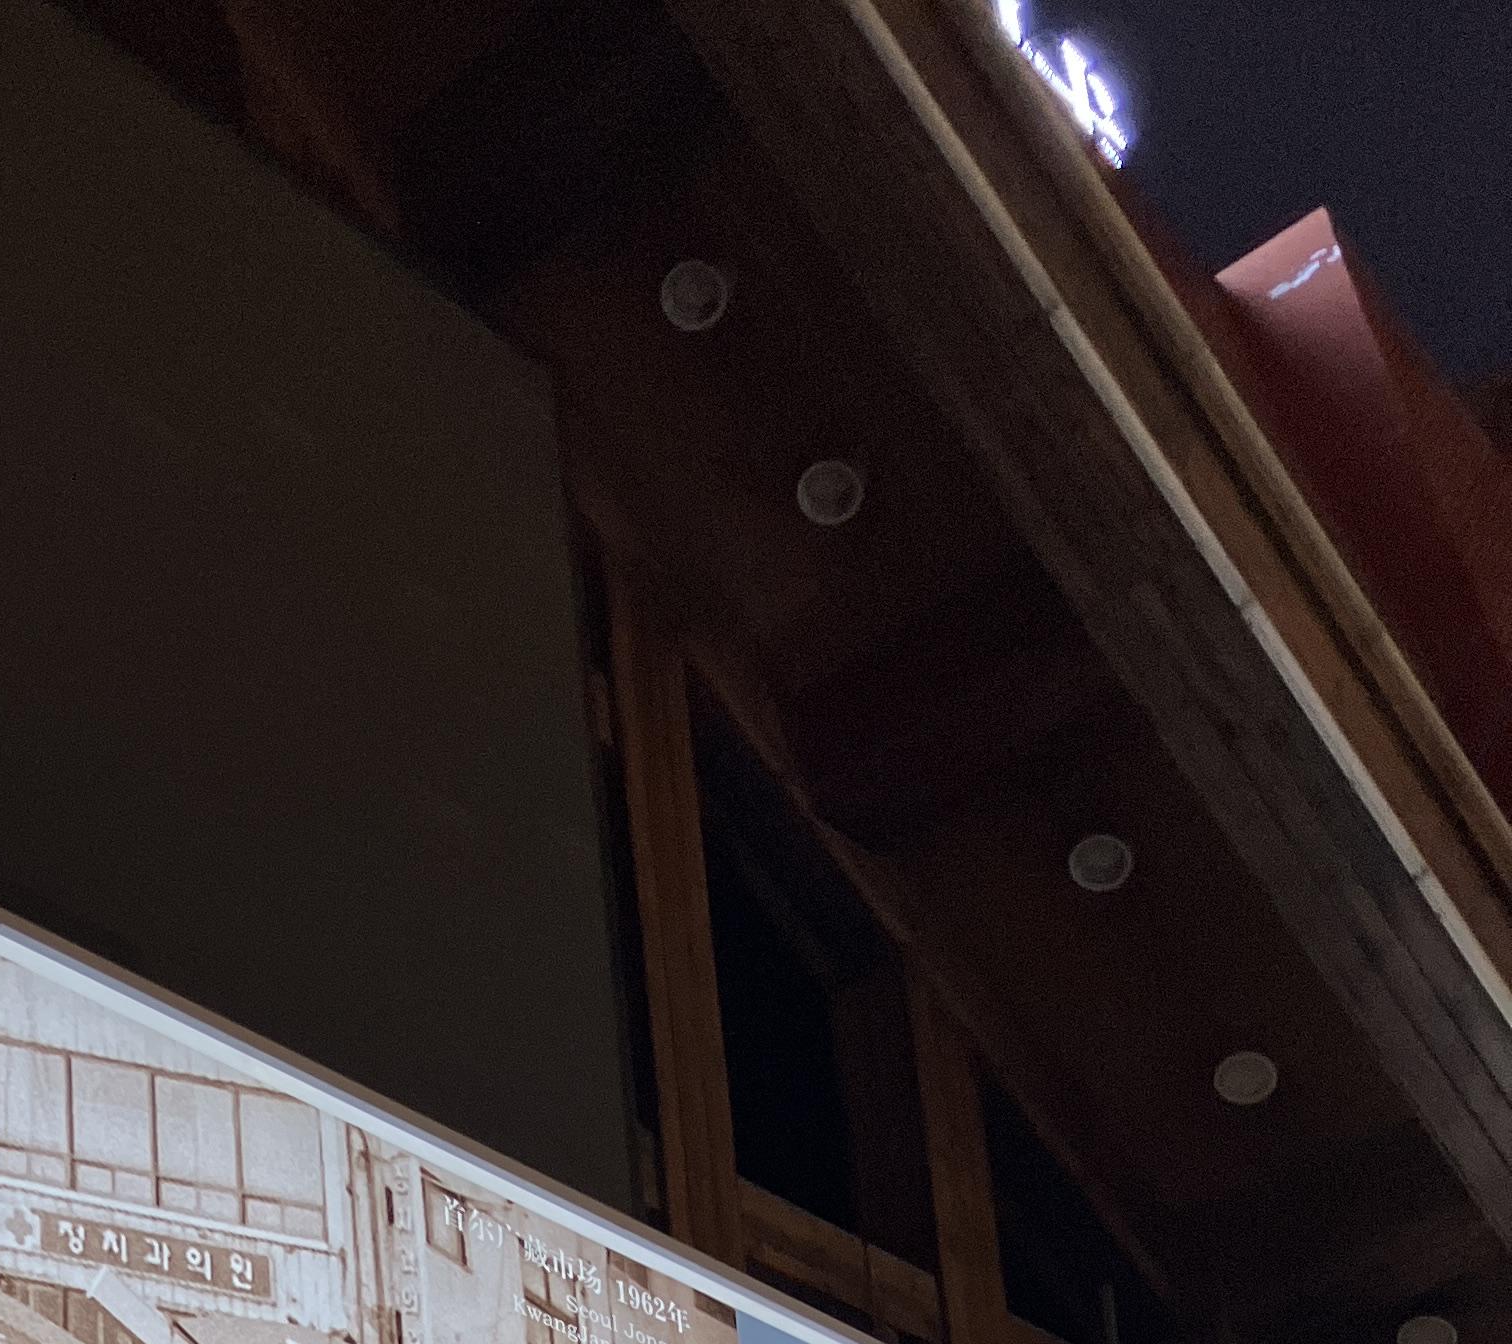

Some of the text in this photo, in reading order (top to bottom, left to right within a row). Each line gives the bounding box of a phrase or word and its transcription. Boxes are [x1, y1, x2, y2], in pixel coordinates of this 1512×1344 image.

[57, 1220, 254, 1290] 정치과의원
[443, 1195, 691, 1334] 首尔广藏市场 1962年
[566, 1295, 619, 1333] Seoul
